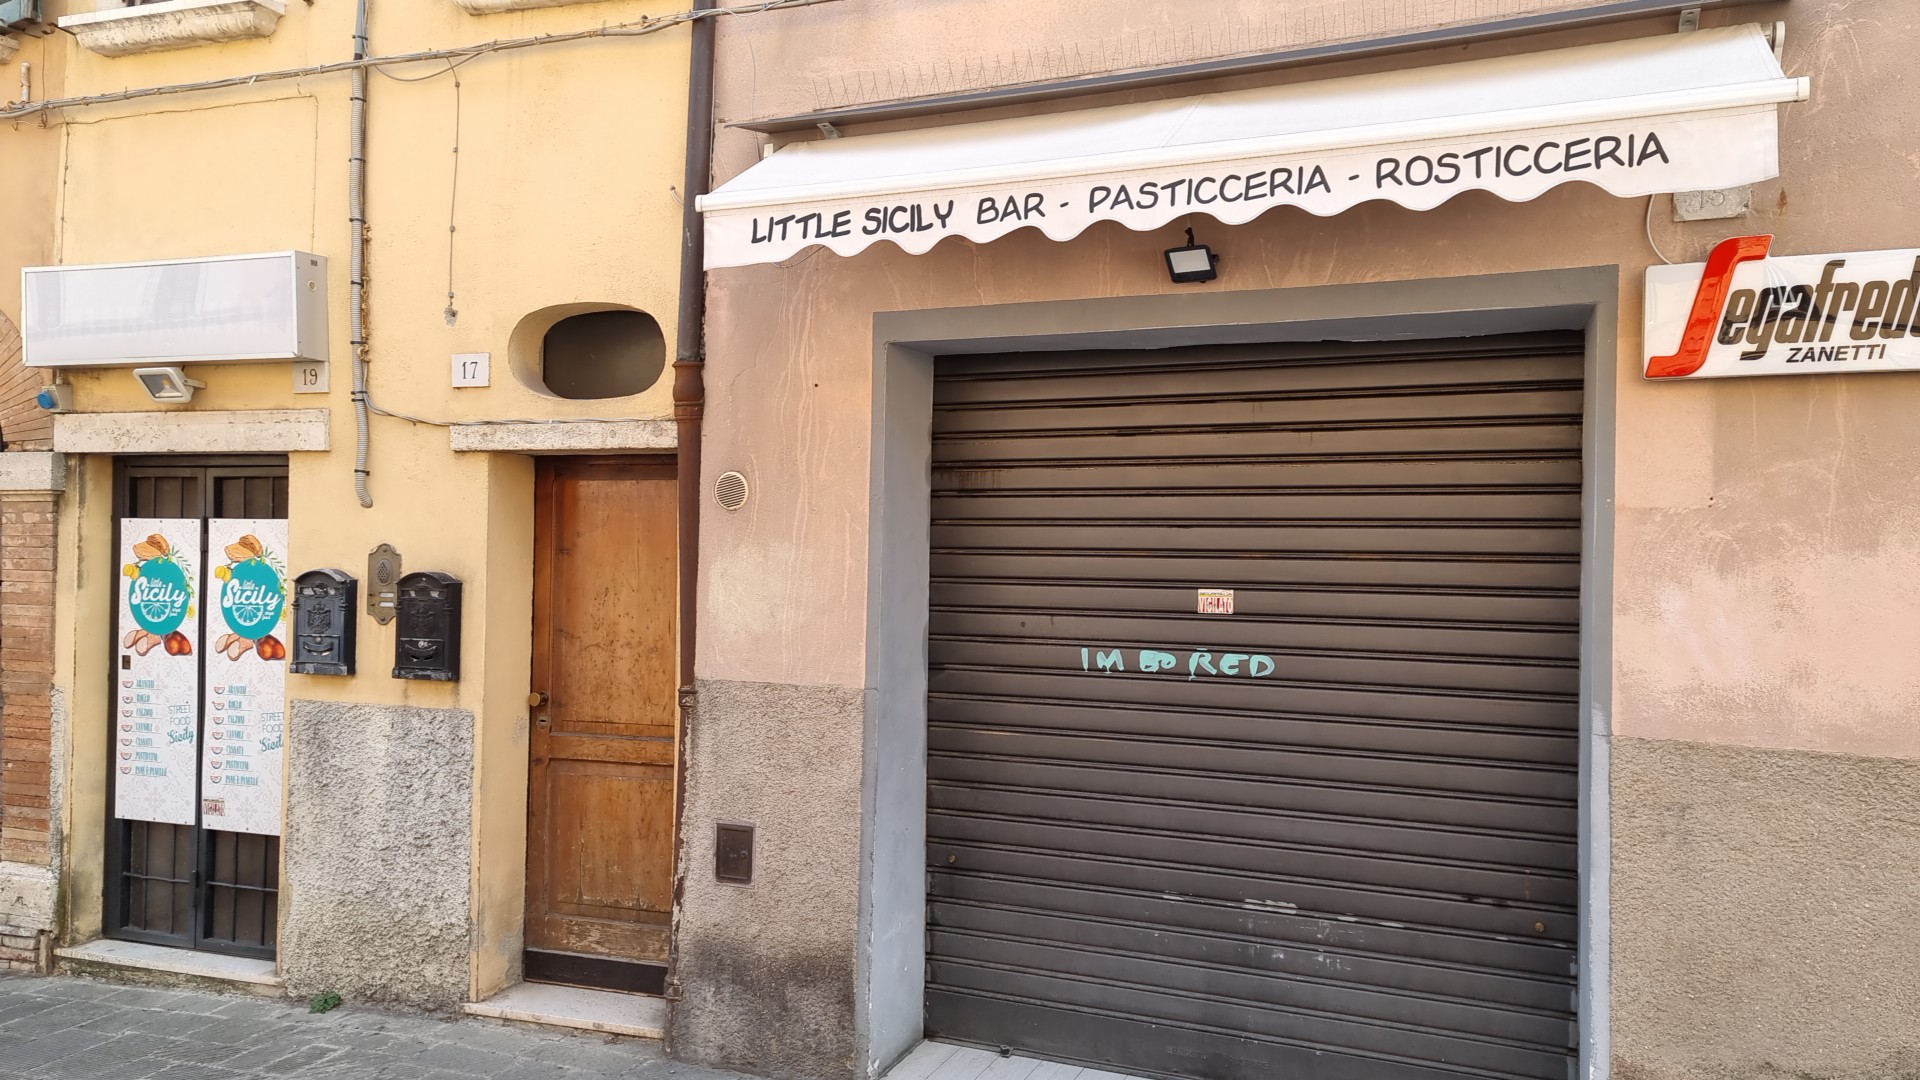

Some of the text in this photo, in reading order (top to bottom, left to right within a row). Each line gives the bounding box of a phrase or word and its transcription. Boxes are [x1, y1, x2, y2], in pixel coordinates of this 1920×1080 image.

[751, 210, 851, 244] LITTLE
[862, 200, 954, 236] SICILY
[976, 192, 1046, 224] BAR
[1088, 164, 1332, 214] PASTICCERIA
[1376, 131, 1670, 189] ROSTICCERIA
[1786, 343, 1887, 363] ZANETTI
[302, 368, 318, 386] 19
[461, 361, 479, 380] 17
[130, 576, 188, 608] Sicily
[222, 578, 282, 611] Sicily
[167, 704, 192, 714] STREET
[169, 716, 192, 726] FOOD
[166, 726, 194, 744] Sicily
[258, 733, 284, 752] Sicil
